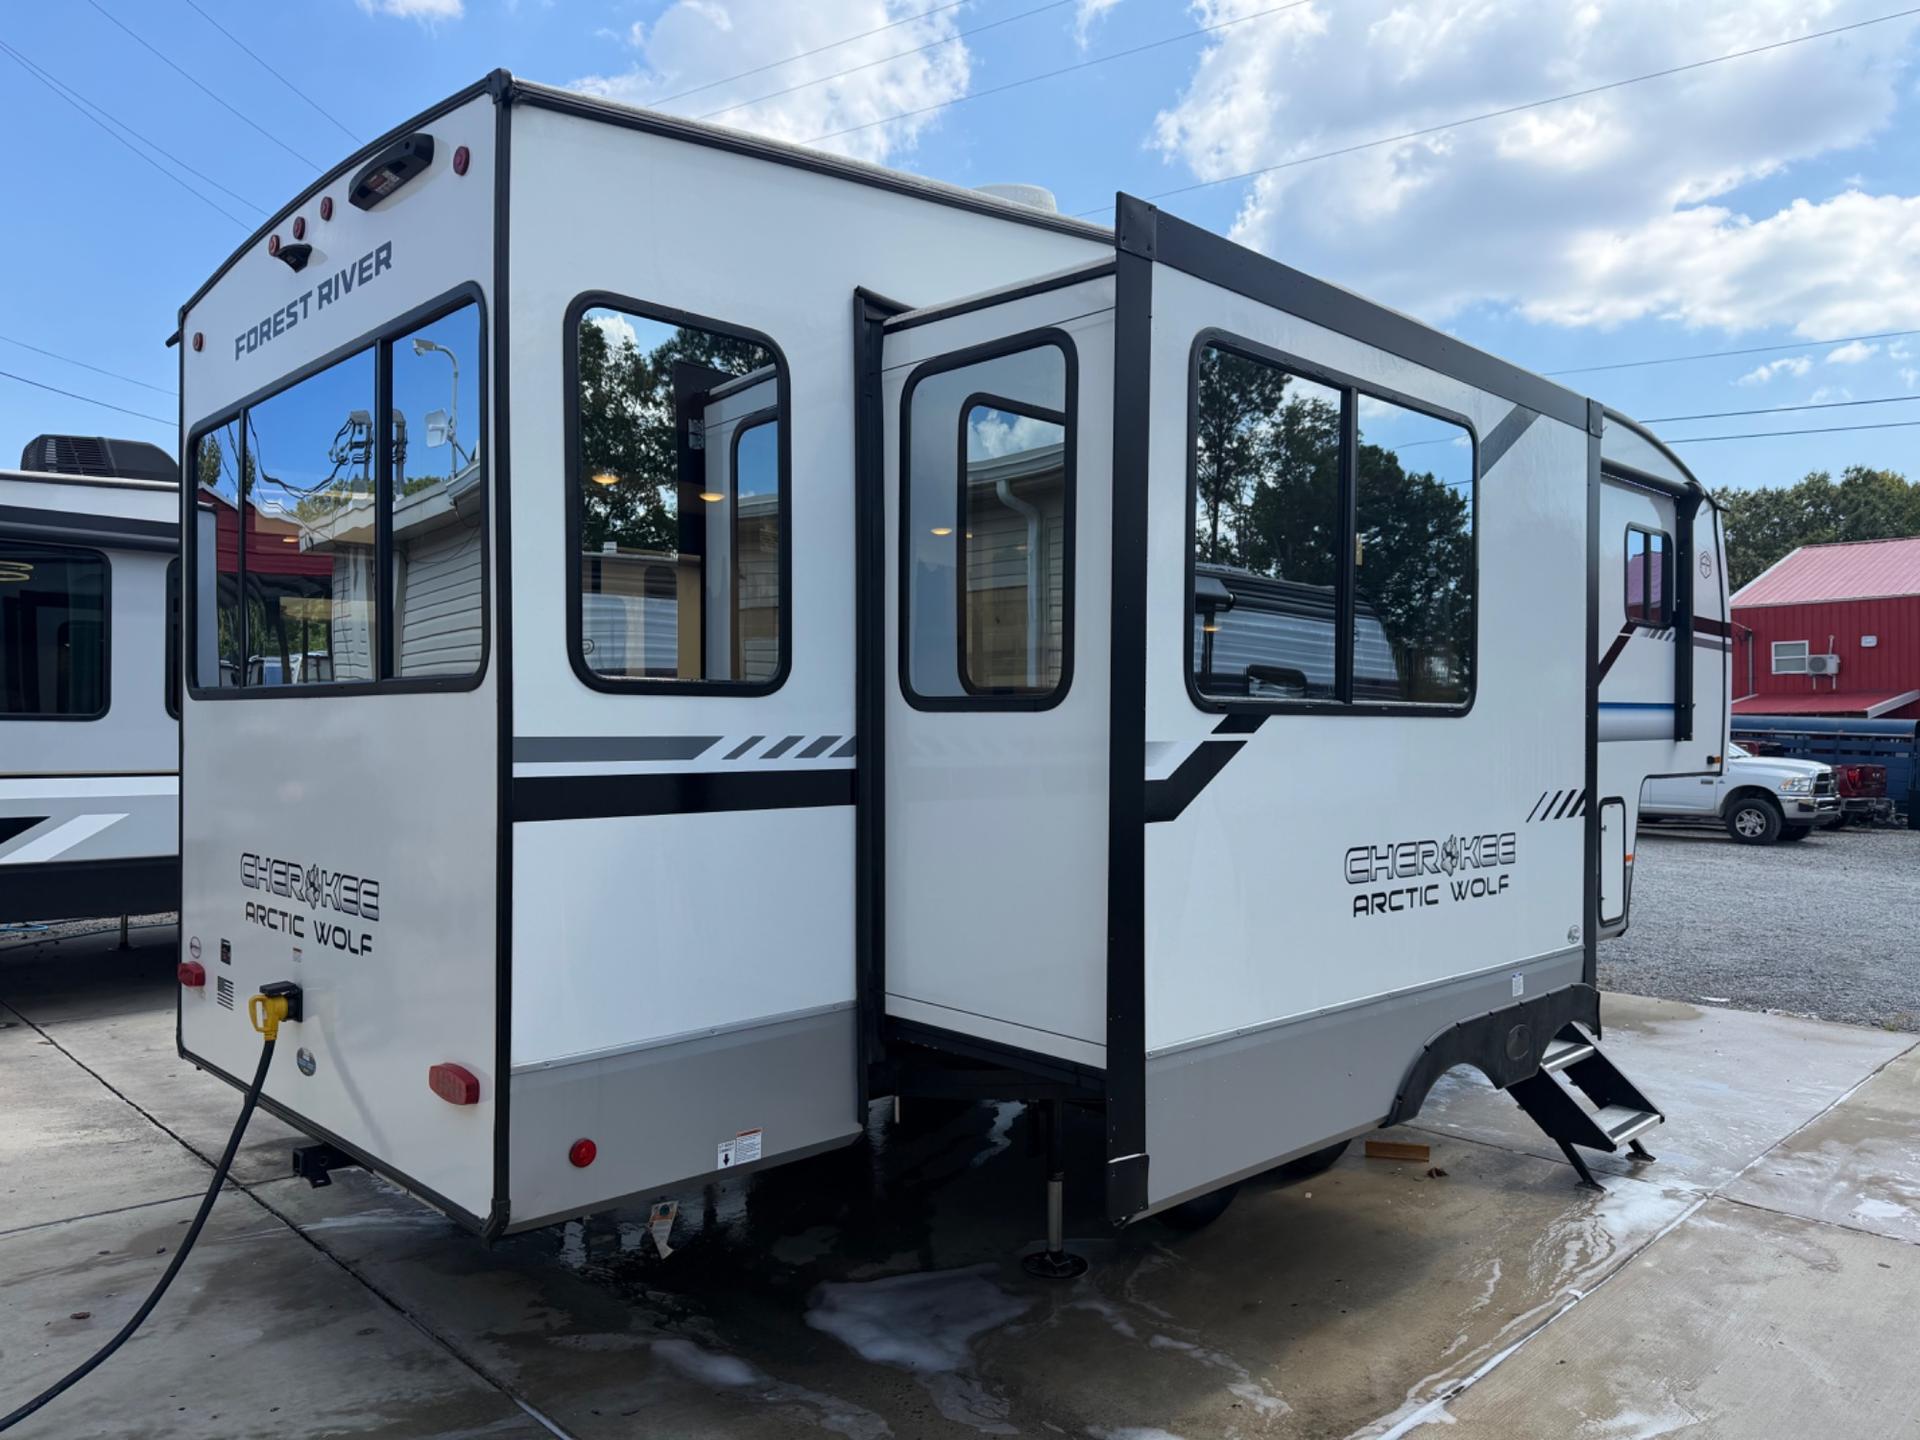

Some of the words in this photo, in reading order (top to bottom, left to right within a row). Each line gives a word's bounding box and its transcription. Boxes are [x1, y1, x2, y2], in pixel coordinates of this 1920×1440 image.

[235, 290, 312, 361] FOREST
[317, 240, 392, 310] RIVER
[1353, 884, 1439, 918] ARCTIC
[1450, 875, 1509, 902] WOLF
[246, 902, 304, 938] ARCTIC
[314, 920, 372, 956] WOLF
